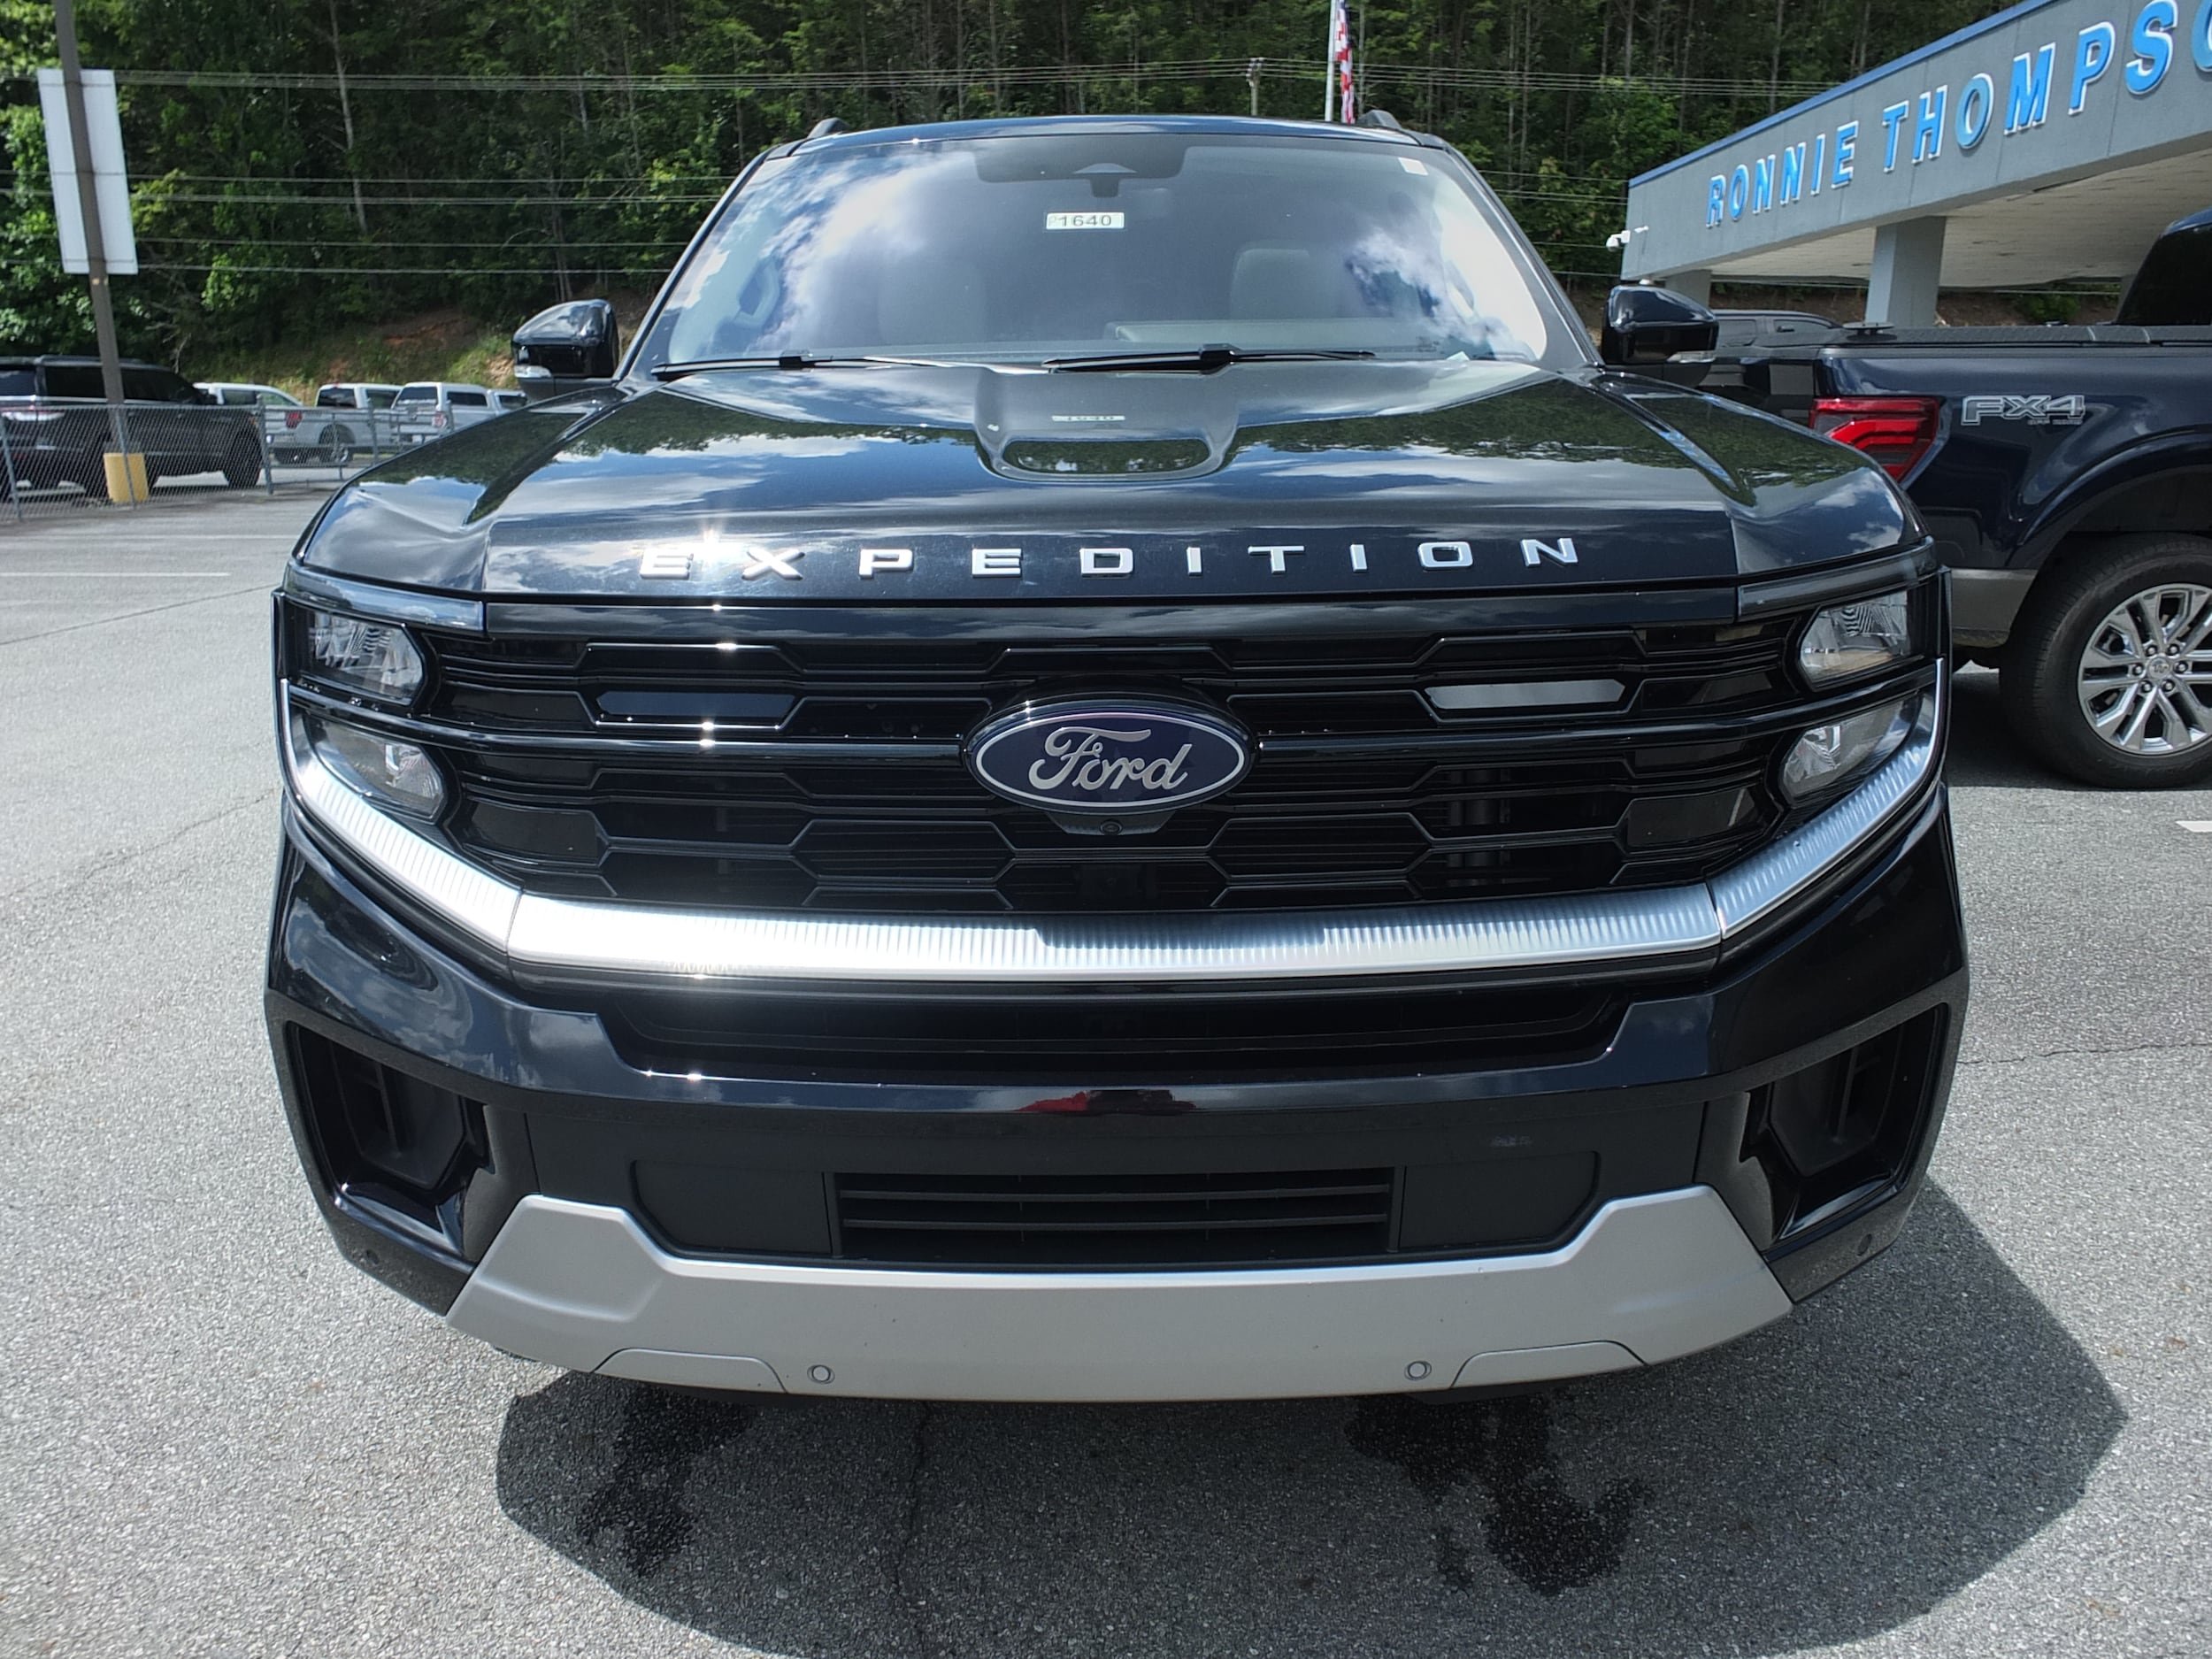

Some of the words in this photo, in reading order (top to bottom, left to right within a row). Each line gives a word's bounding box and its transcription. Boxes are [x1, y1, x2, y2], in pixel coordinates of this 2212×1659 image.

[1706, 119, 1859, 229] RONNIE
[1961, 395, 2085, 426] FX4
[639, 537, 1578, 580] EXPEDITION
[1028, 726, 1194, 790] Ford
